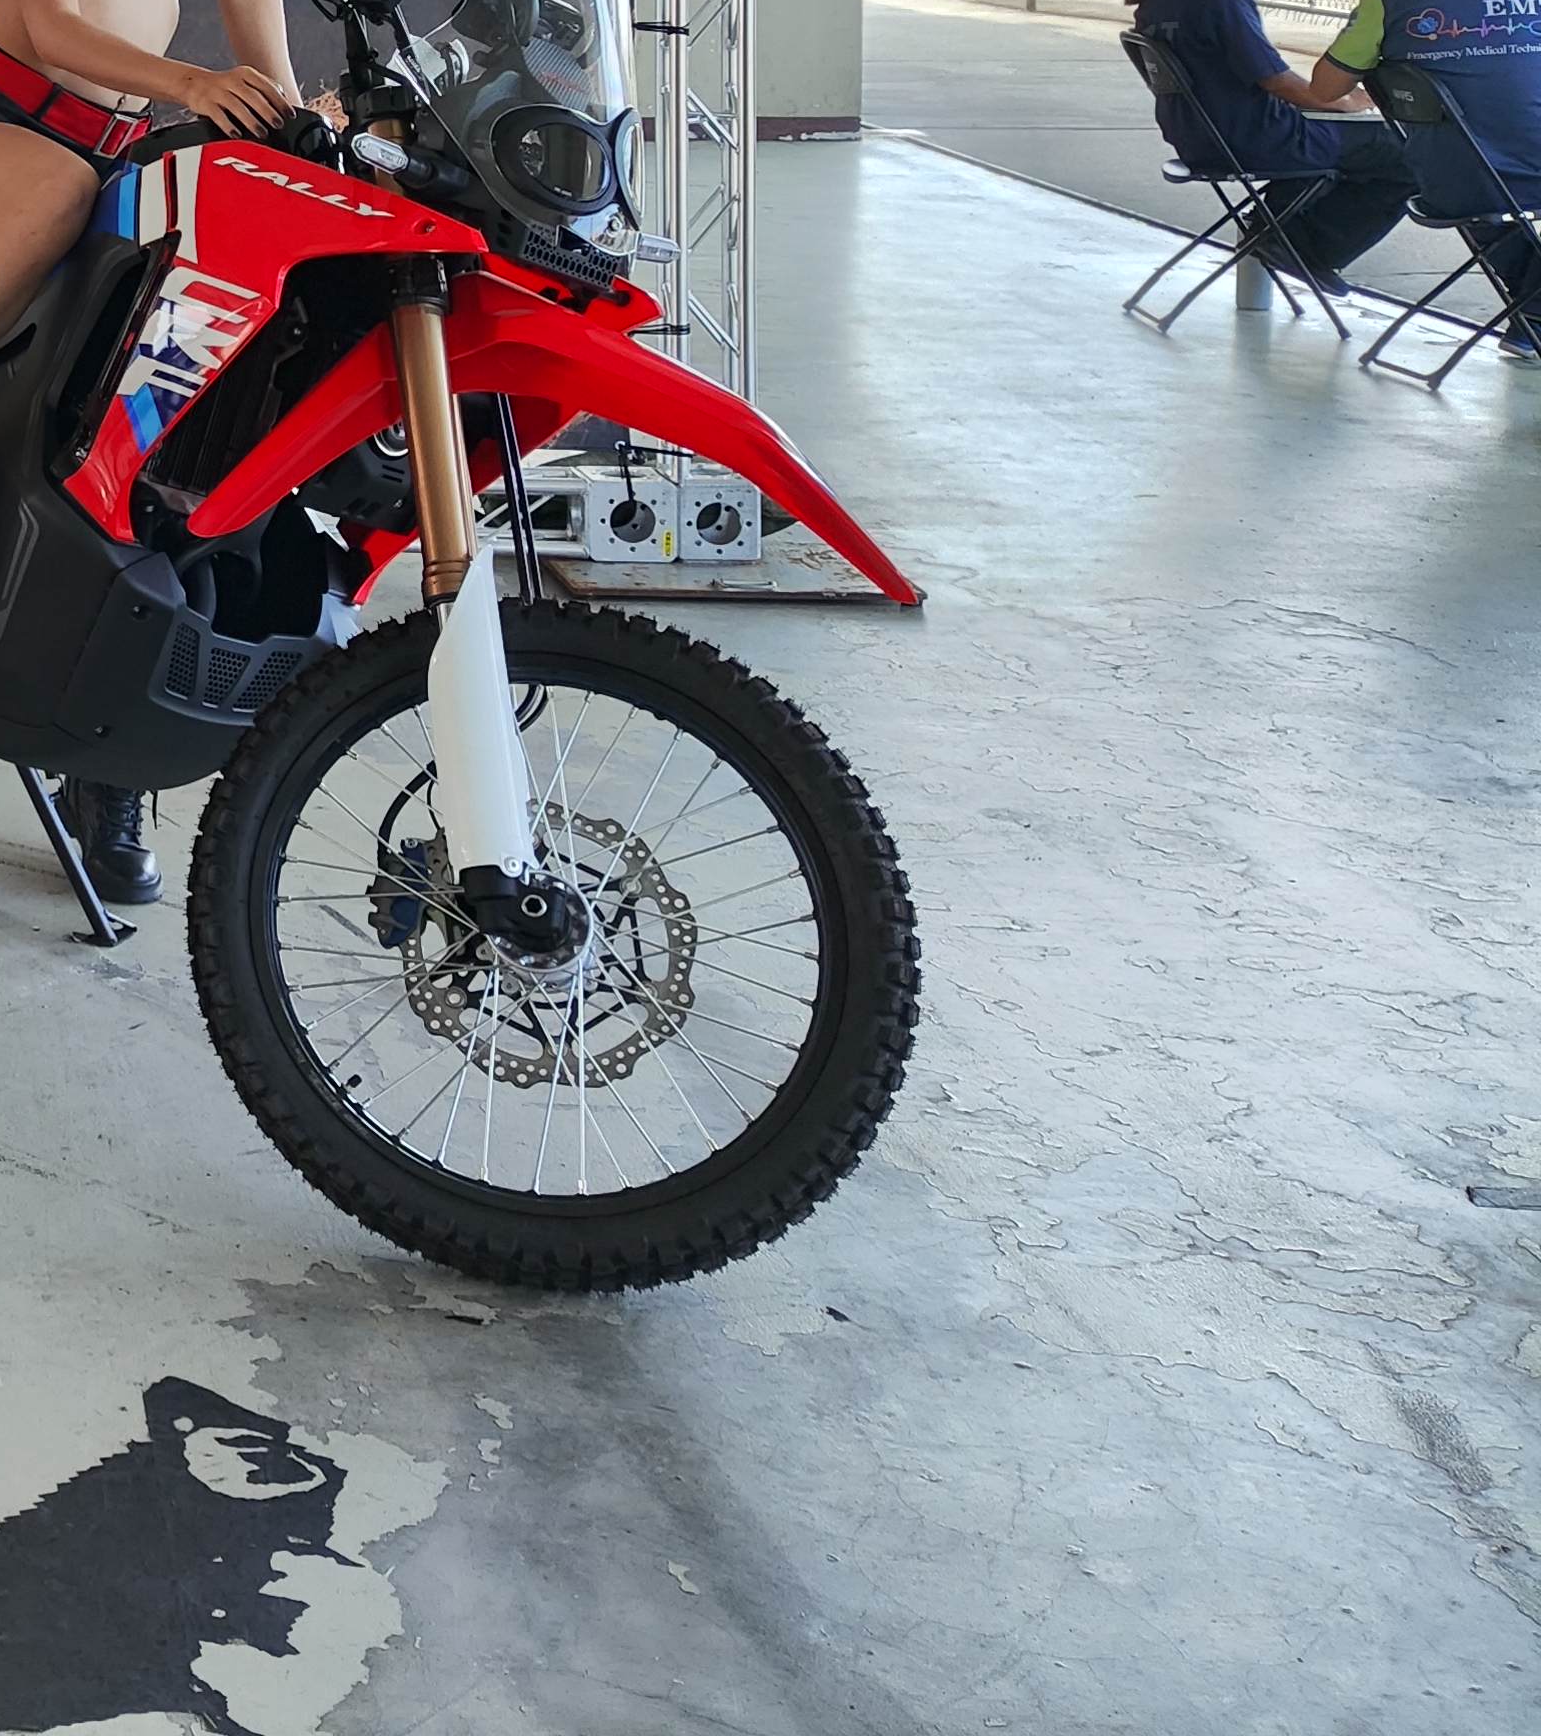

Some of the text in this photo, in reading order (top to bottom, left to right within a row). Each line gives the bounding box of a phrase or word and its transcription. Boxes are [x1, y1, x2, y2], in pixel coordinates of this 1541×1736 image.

[1406, 48, 1463, 61] Emergency
[1466, 44, 1507, 57] Medical
[213, 156, 396, 218] RALLY
